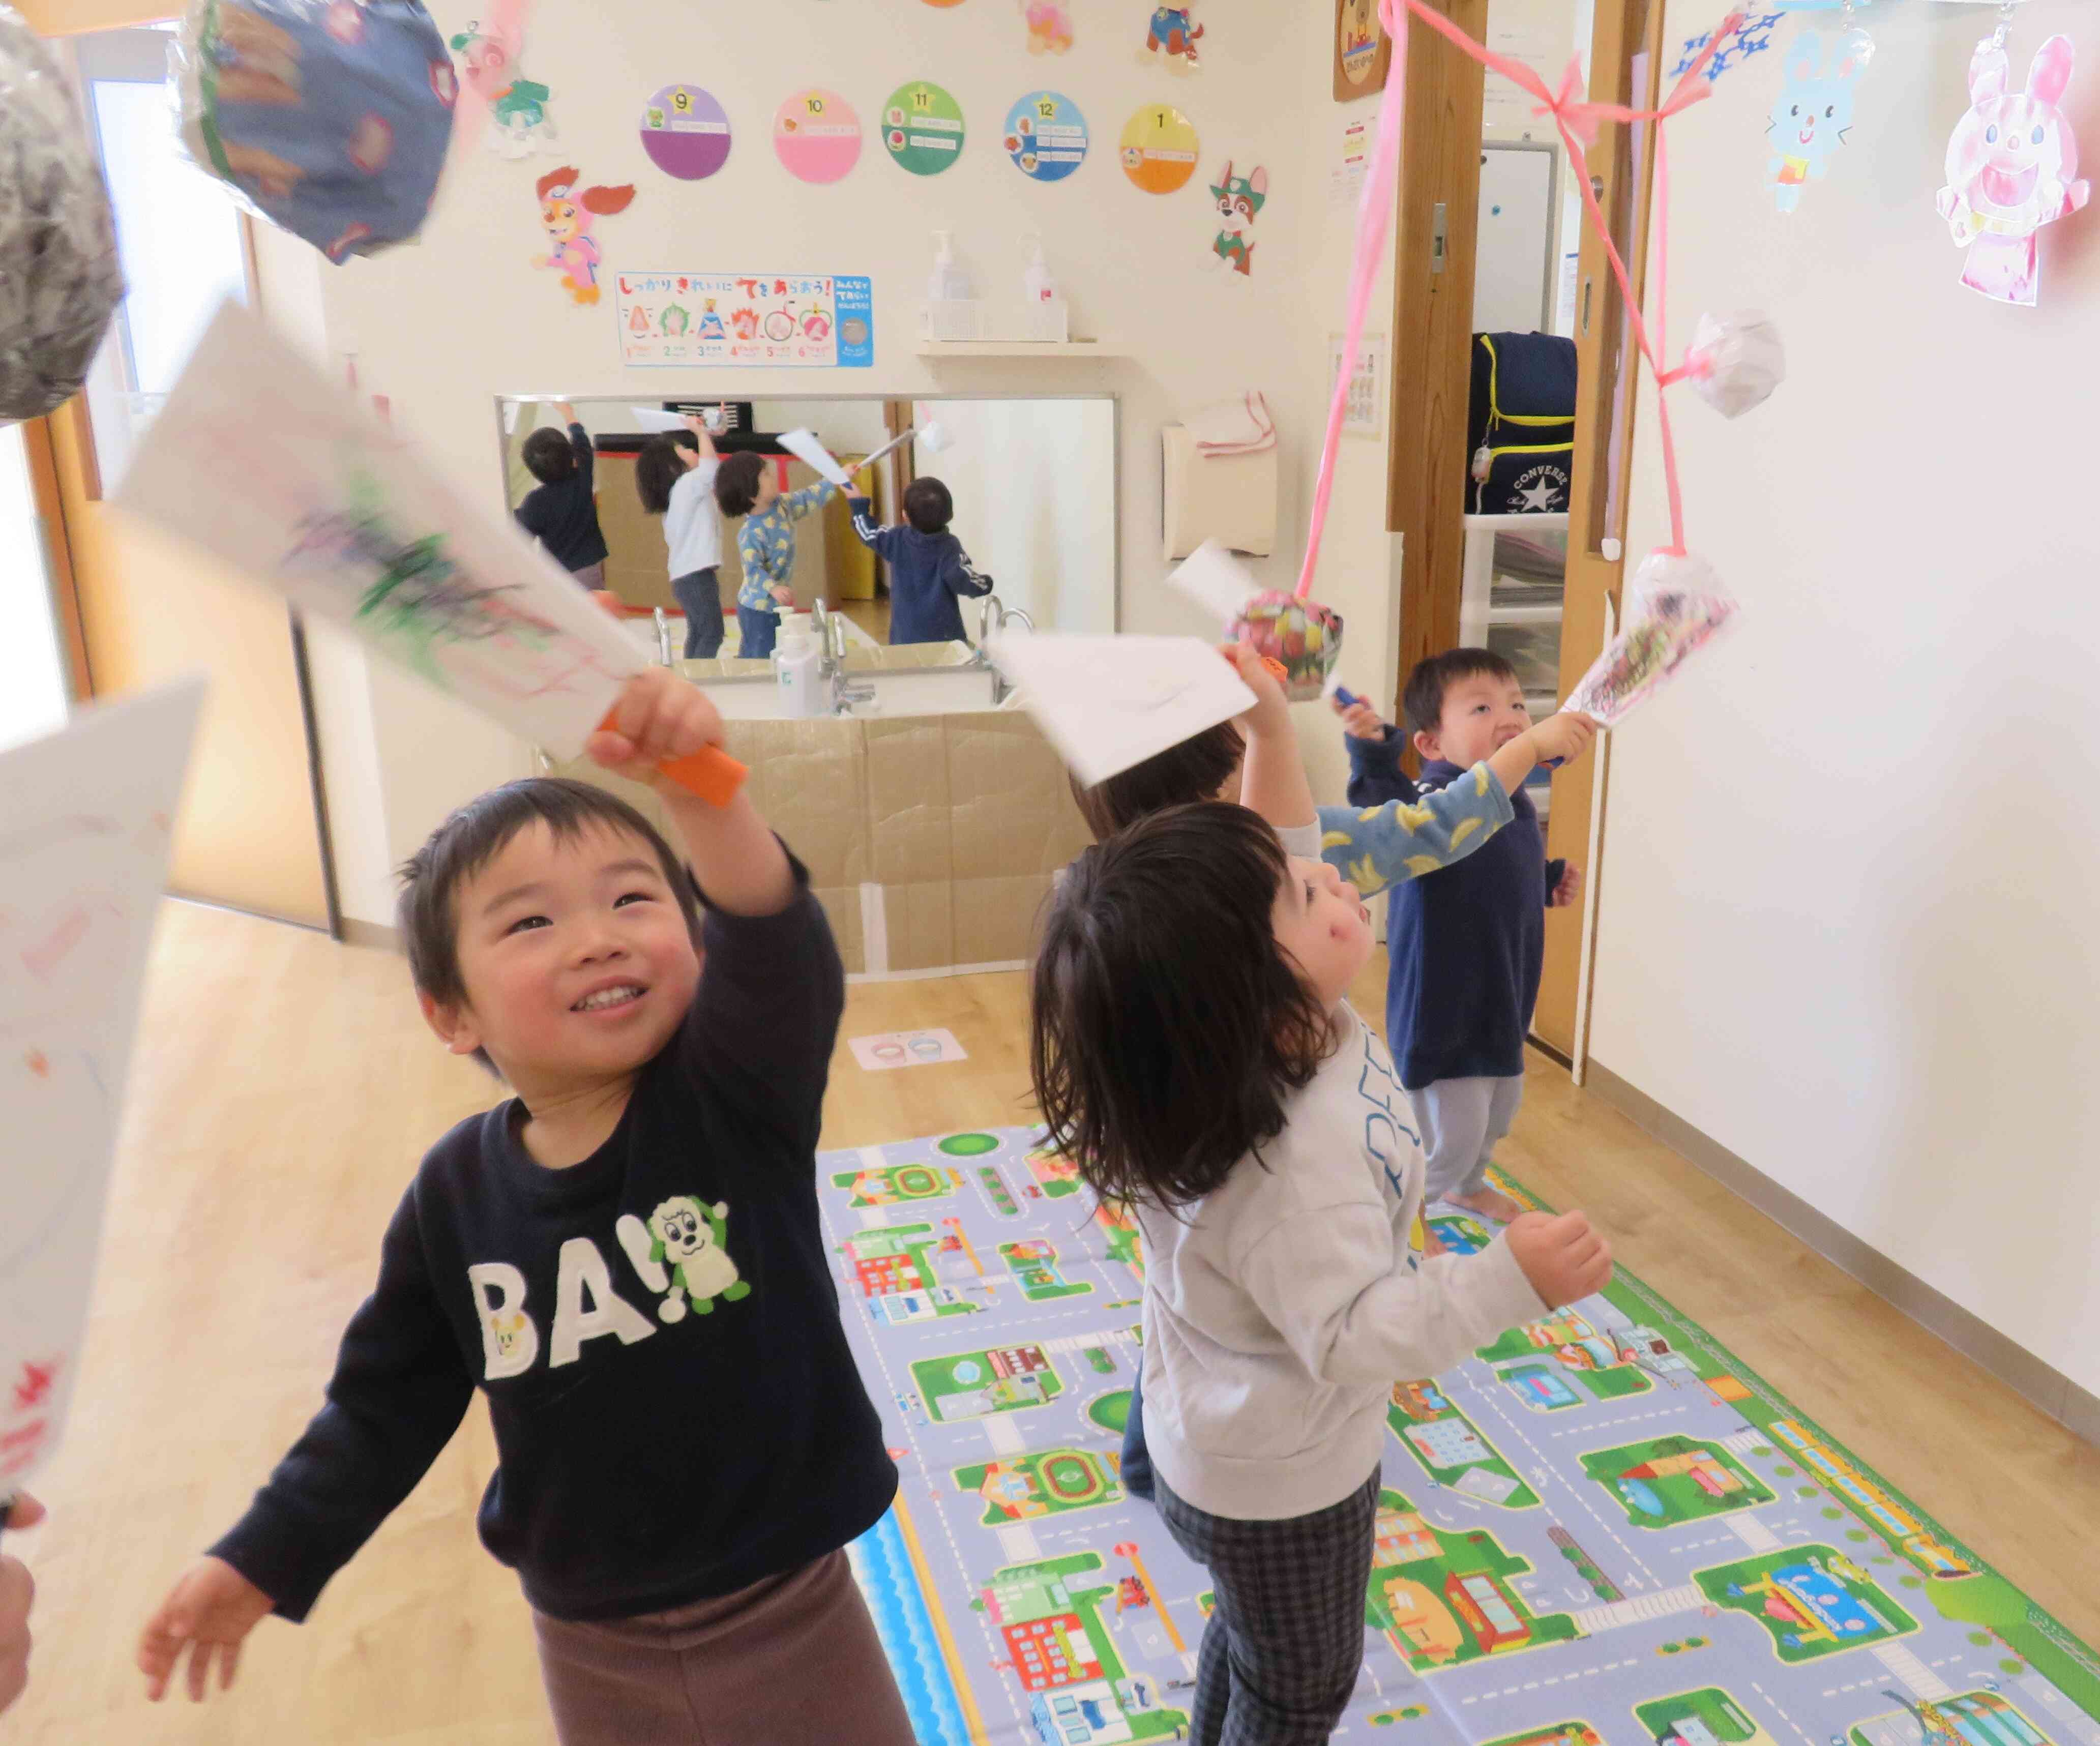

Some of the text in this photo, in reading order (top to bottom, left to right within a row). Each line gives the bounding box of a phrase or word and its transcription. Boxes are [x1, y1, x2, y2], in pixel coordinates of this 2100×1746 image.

[676, 93, 687, 109] 9
[807, 100, 822, 112] 10
[915, 94, 927, 106] 11
[1039, 103, 1053, 116] 12
[1157, 113, 1164, 128] 1
[663, 346, 670, 357] 2
[698, 346, 704, 357] 3
[767, 346, 773, 357] 5
[1514, 465, 1567, 489] CONVERSE
